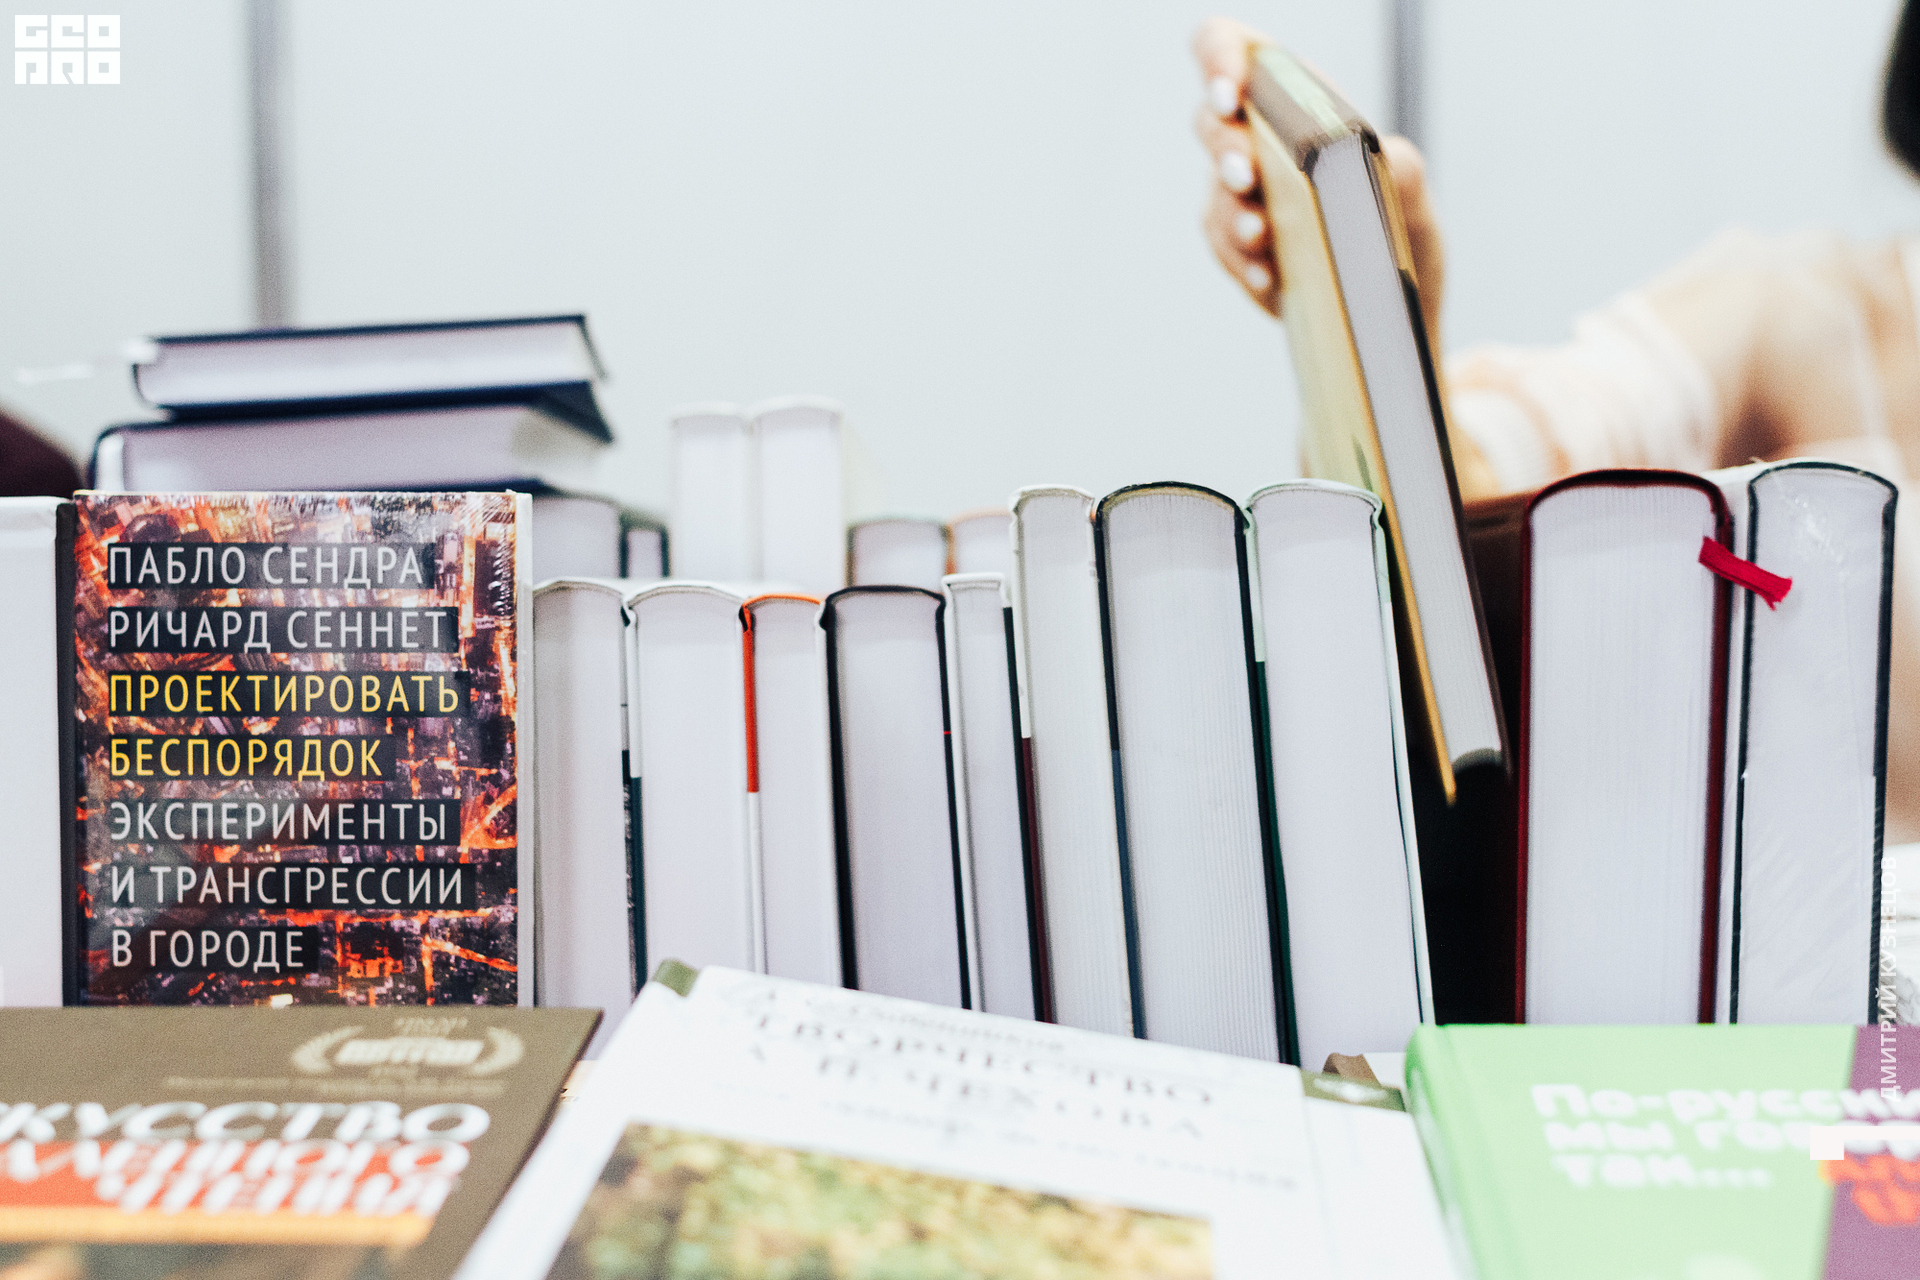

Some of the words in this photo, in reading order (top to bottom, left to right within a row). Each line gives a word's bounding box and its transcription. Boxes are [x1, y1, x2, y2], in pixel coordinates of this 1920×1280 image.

[108, 546, 247, 586] ПАБЛО
[262, 546, 424, 589] СЕНДРА
[109, 610, 271, 653] РИЧАРД
[286, 610, 447, 649] СЕННЕТ
[109, 674, 460, 713] ПРОЕКТИРОВАТЬ
[110, 738, 383, 780] БЕСПОРЯДОК
[110, 802, 446, 841] ЭКСПЕРИМЕНТЫ
[112, 867, 135, 904] И
[151, 866, 463, 904] ТРАНСГРЕССИИ
[112, 931, 133, 967] В
[150, 930, 304, 972] ГОРОДЕ
[0, 1101, 490, 1142] КУССТВО
